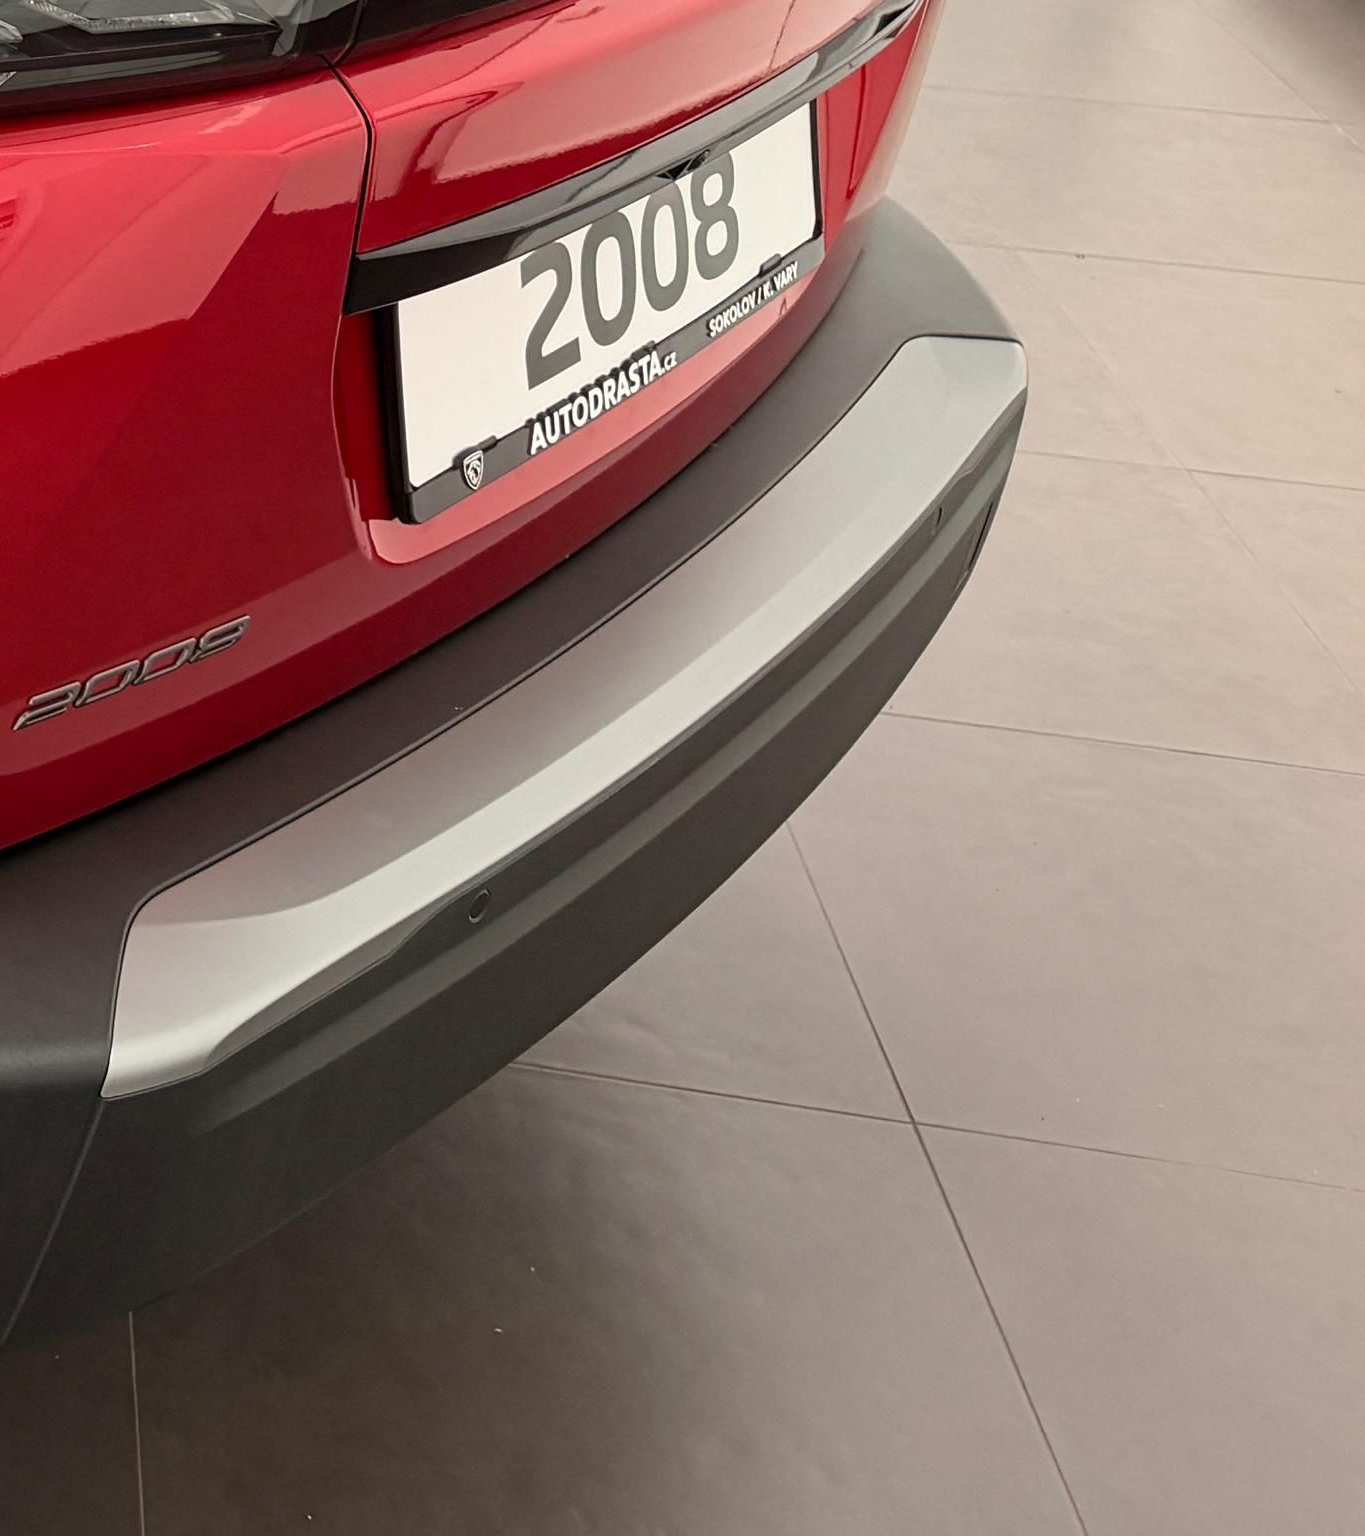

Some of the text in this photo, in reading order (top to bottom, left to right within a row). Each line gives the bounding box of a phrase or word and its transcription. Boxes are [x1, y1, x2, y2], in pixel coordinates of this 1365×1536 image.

[519, 152, 740, 391] 2008
[708, 291, 756, 337] SOKOLOV
[773, 261, 798, 291] VARY
[529, 350, 677, 456] AUTODRASTA.cz
[12, 614, 251, 731] 2008
